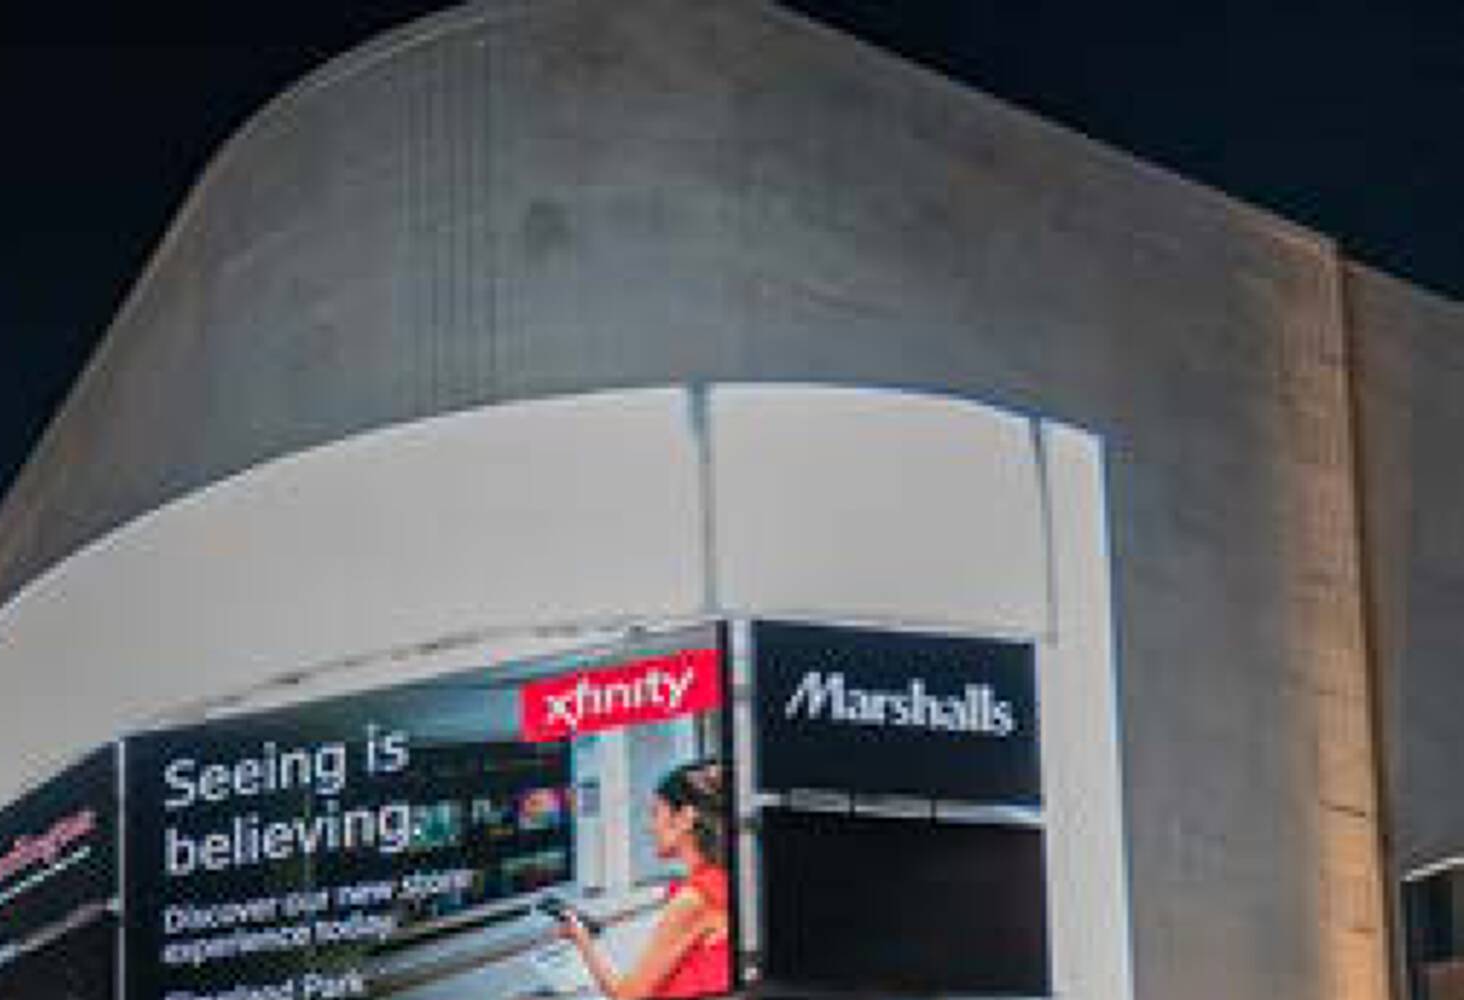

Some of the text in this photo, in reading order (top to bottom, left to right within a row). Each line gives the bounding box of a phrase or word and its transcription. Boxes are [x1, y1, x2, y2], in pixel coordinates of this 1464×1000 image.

[542, 664, 695, 727] xfinity
[785, 671, 1015, 737] Marshalls
[164, 722, 410, 808] Seeing is
[164, 897, 277, 935] Discover
[280, 890, 329, 917] our
[336, 883, 393, 906] new
[162, 927, 311, 968] experience
